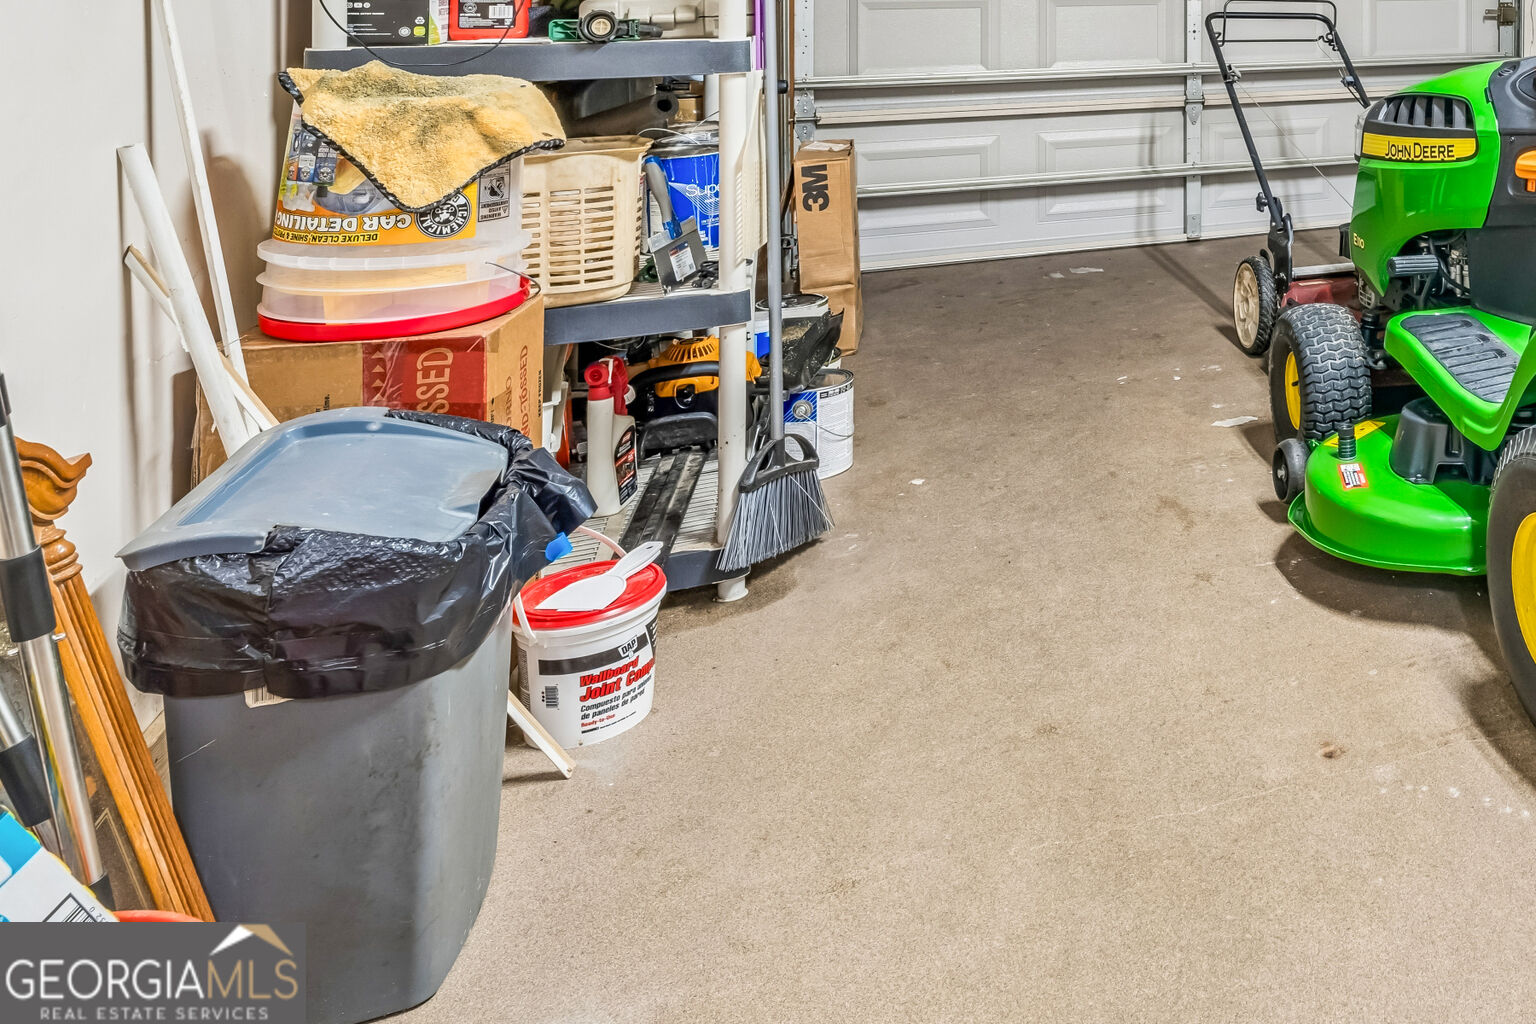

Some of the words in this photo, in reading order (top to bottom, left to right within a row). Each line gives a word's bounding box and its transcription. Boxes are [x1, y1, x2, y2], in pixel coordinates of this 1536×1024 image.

[1385, 140, 1412, 157] JOHN
[1413, 142, 1455, 158] DEERE
[801, 163, 830, 212] 3M
[277, 211, 358, 232] DETAILING
[362, 213, 412, 232] CAR
[289, 233, 308, 242] SHINE
[310, 233, 340, 243] CLEAN,
[340, 233, 378, 243] DELUXE
[620, 638, 637, 656] DAP
[580, 655, 640, 688] Wallboard
[579, 676, 622, 703] Joint
[580, 694, 621, 713] Compuesto
[621, 685, 636, 700] para
[581, 712, 590, 721] de
[591, 704, 620, 720] paneles
[621, 698, 629, 707] de
